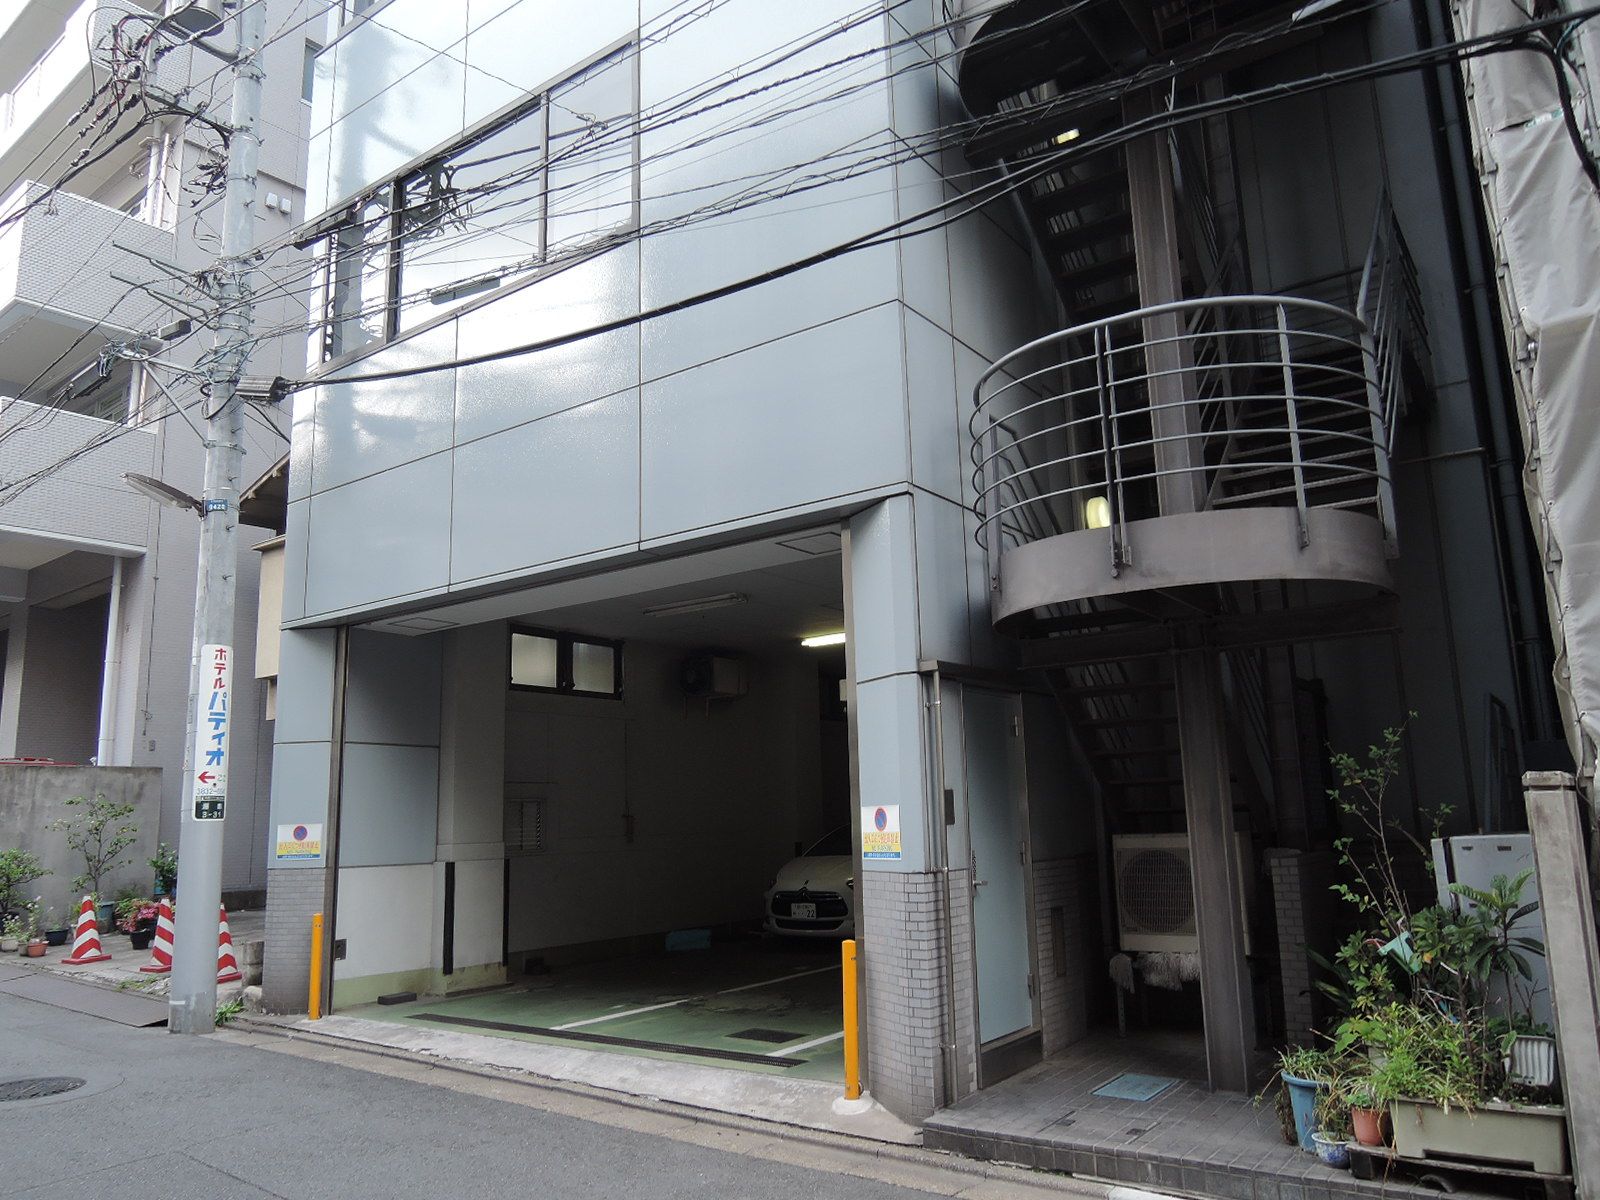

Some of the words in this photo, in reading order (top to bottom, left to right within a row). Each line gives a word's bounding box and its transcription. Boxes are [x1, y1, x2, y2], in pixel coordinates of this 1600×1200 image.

[205, 648, 227, 766] ホテルパティオ
